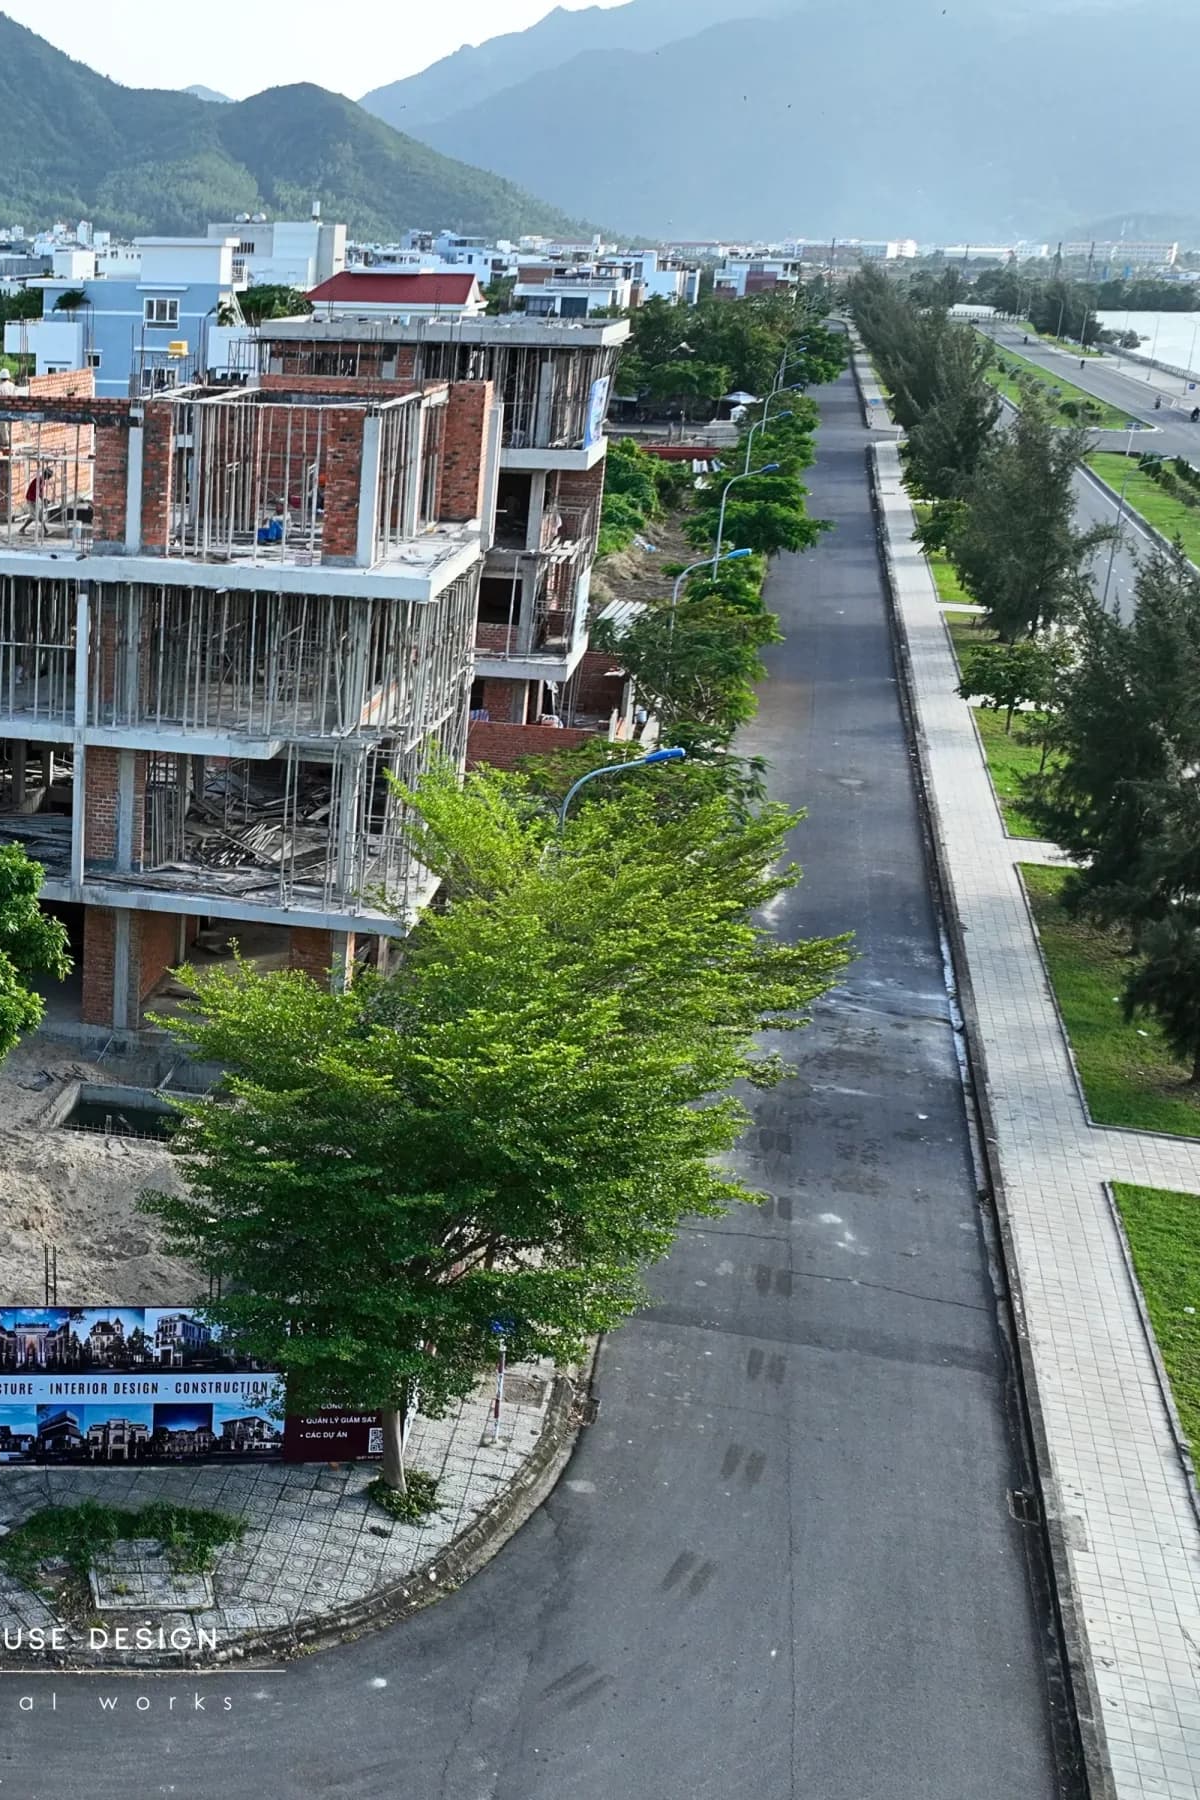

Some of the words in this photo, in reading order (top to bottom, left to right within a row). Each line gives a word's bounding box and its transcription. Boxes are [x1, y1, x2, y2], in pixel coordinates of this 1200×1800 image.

[50, 1382, 108, 1395] INTERIOR
[113, 1382, 159, 1395] DESIGN
[175, 1381, 268, 1394] CONSTRUCTION
[341, 1415, 360, 1424] GIÁM
[305, 1430, 322, 1439] CÁC
[336, 1430, 348, 1438] ÁN
